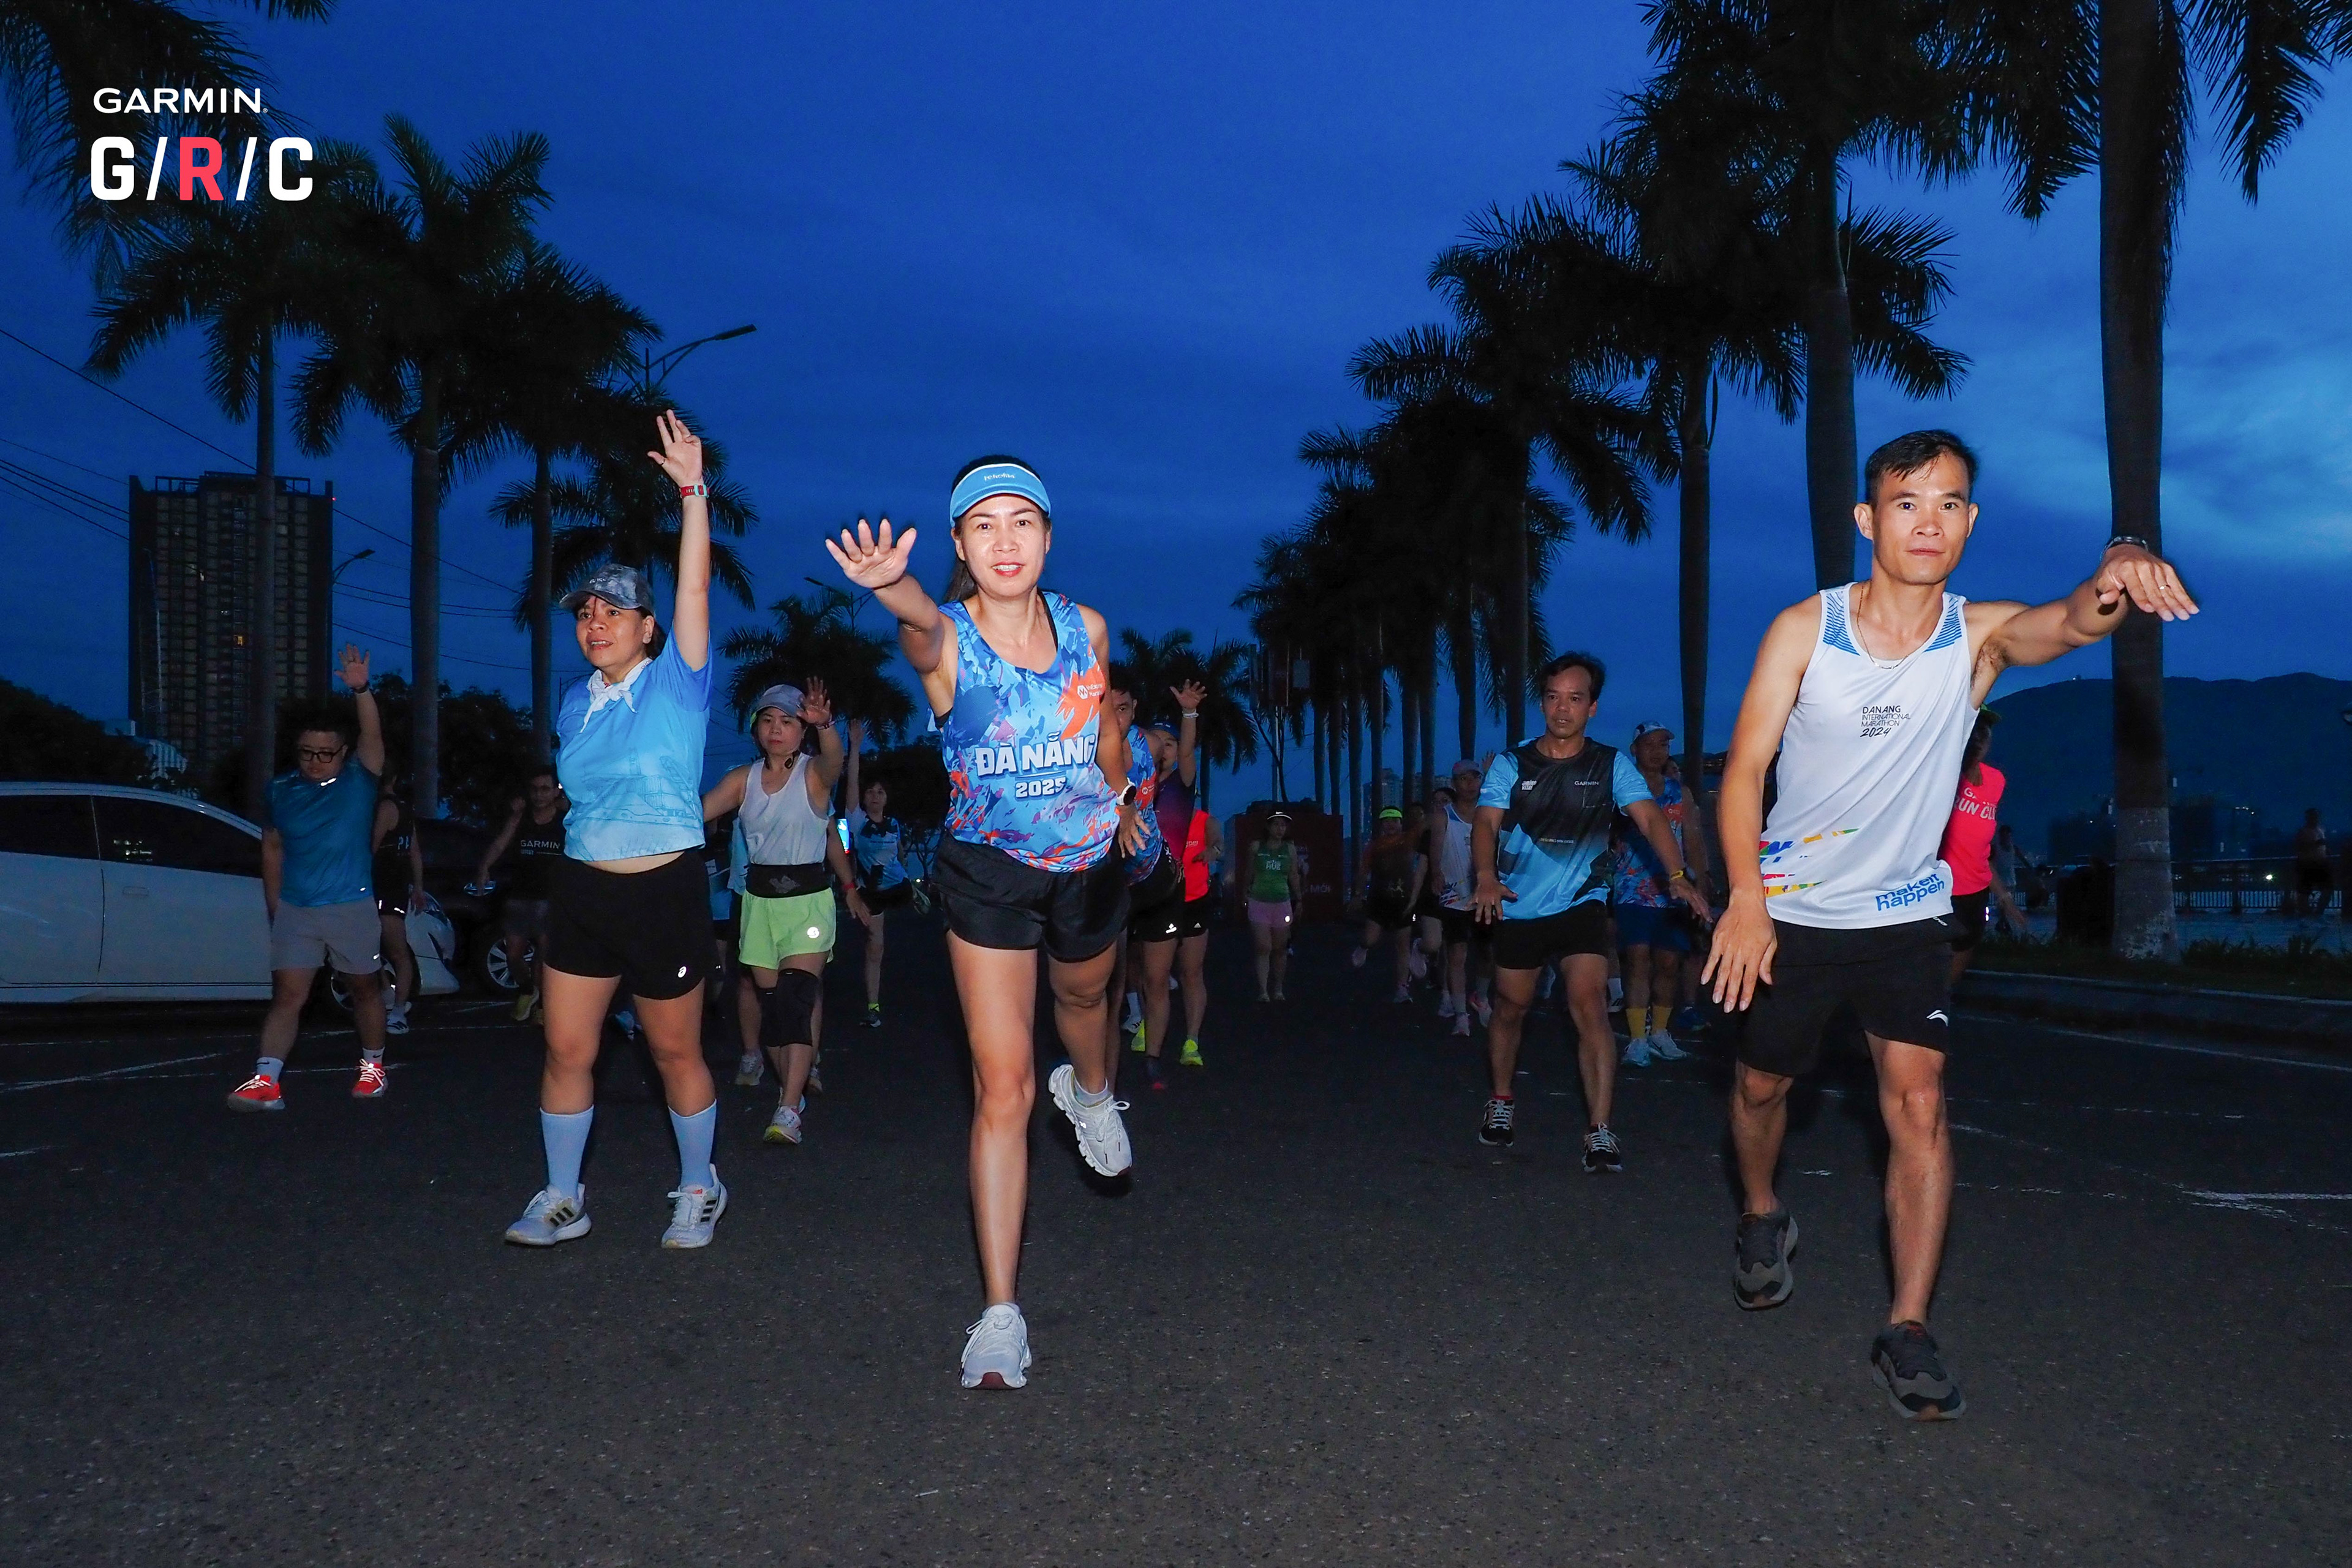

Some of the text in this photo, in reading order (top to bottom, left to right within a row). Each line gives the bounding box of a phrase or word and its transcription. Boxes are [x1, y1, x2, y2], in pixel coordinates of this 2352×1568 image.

[1860, 727, 1892, 737] 2024
[975, 742, 1017, 776] ĐÀ
[1015, 777, 1066, 798] 2025
[520, 839, 560, 850] GARMIN
[1875, 880, 1945, 911] happen
